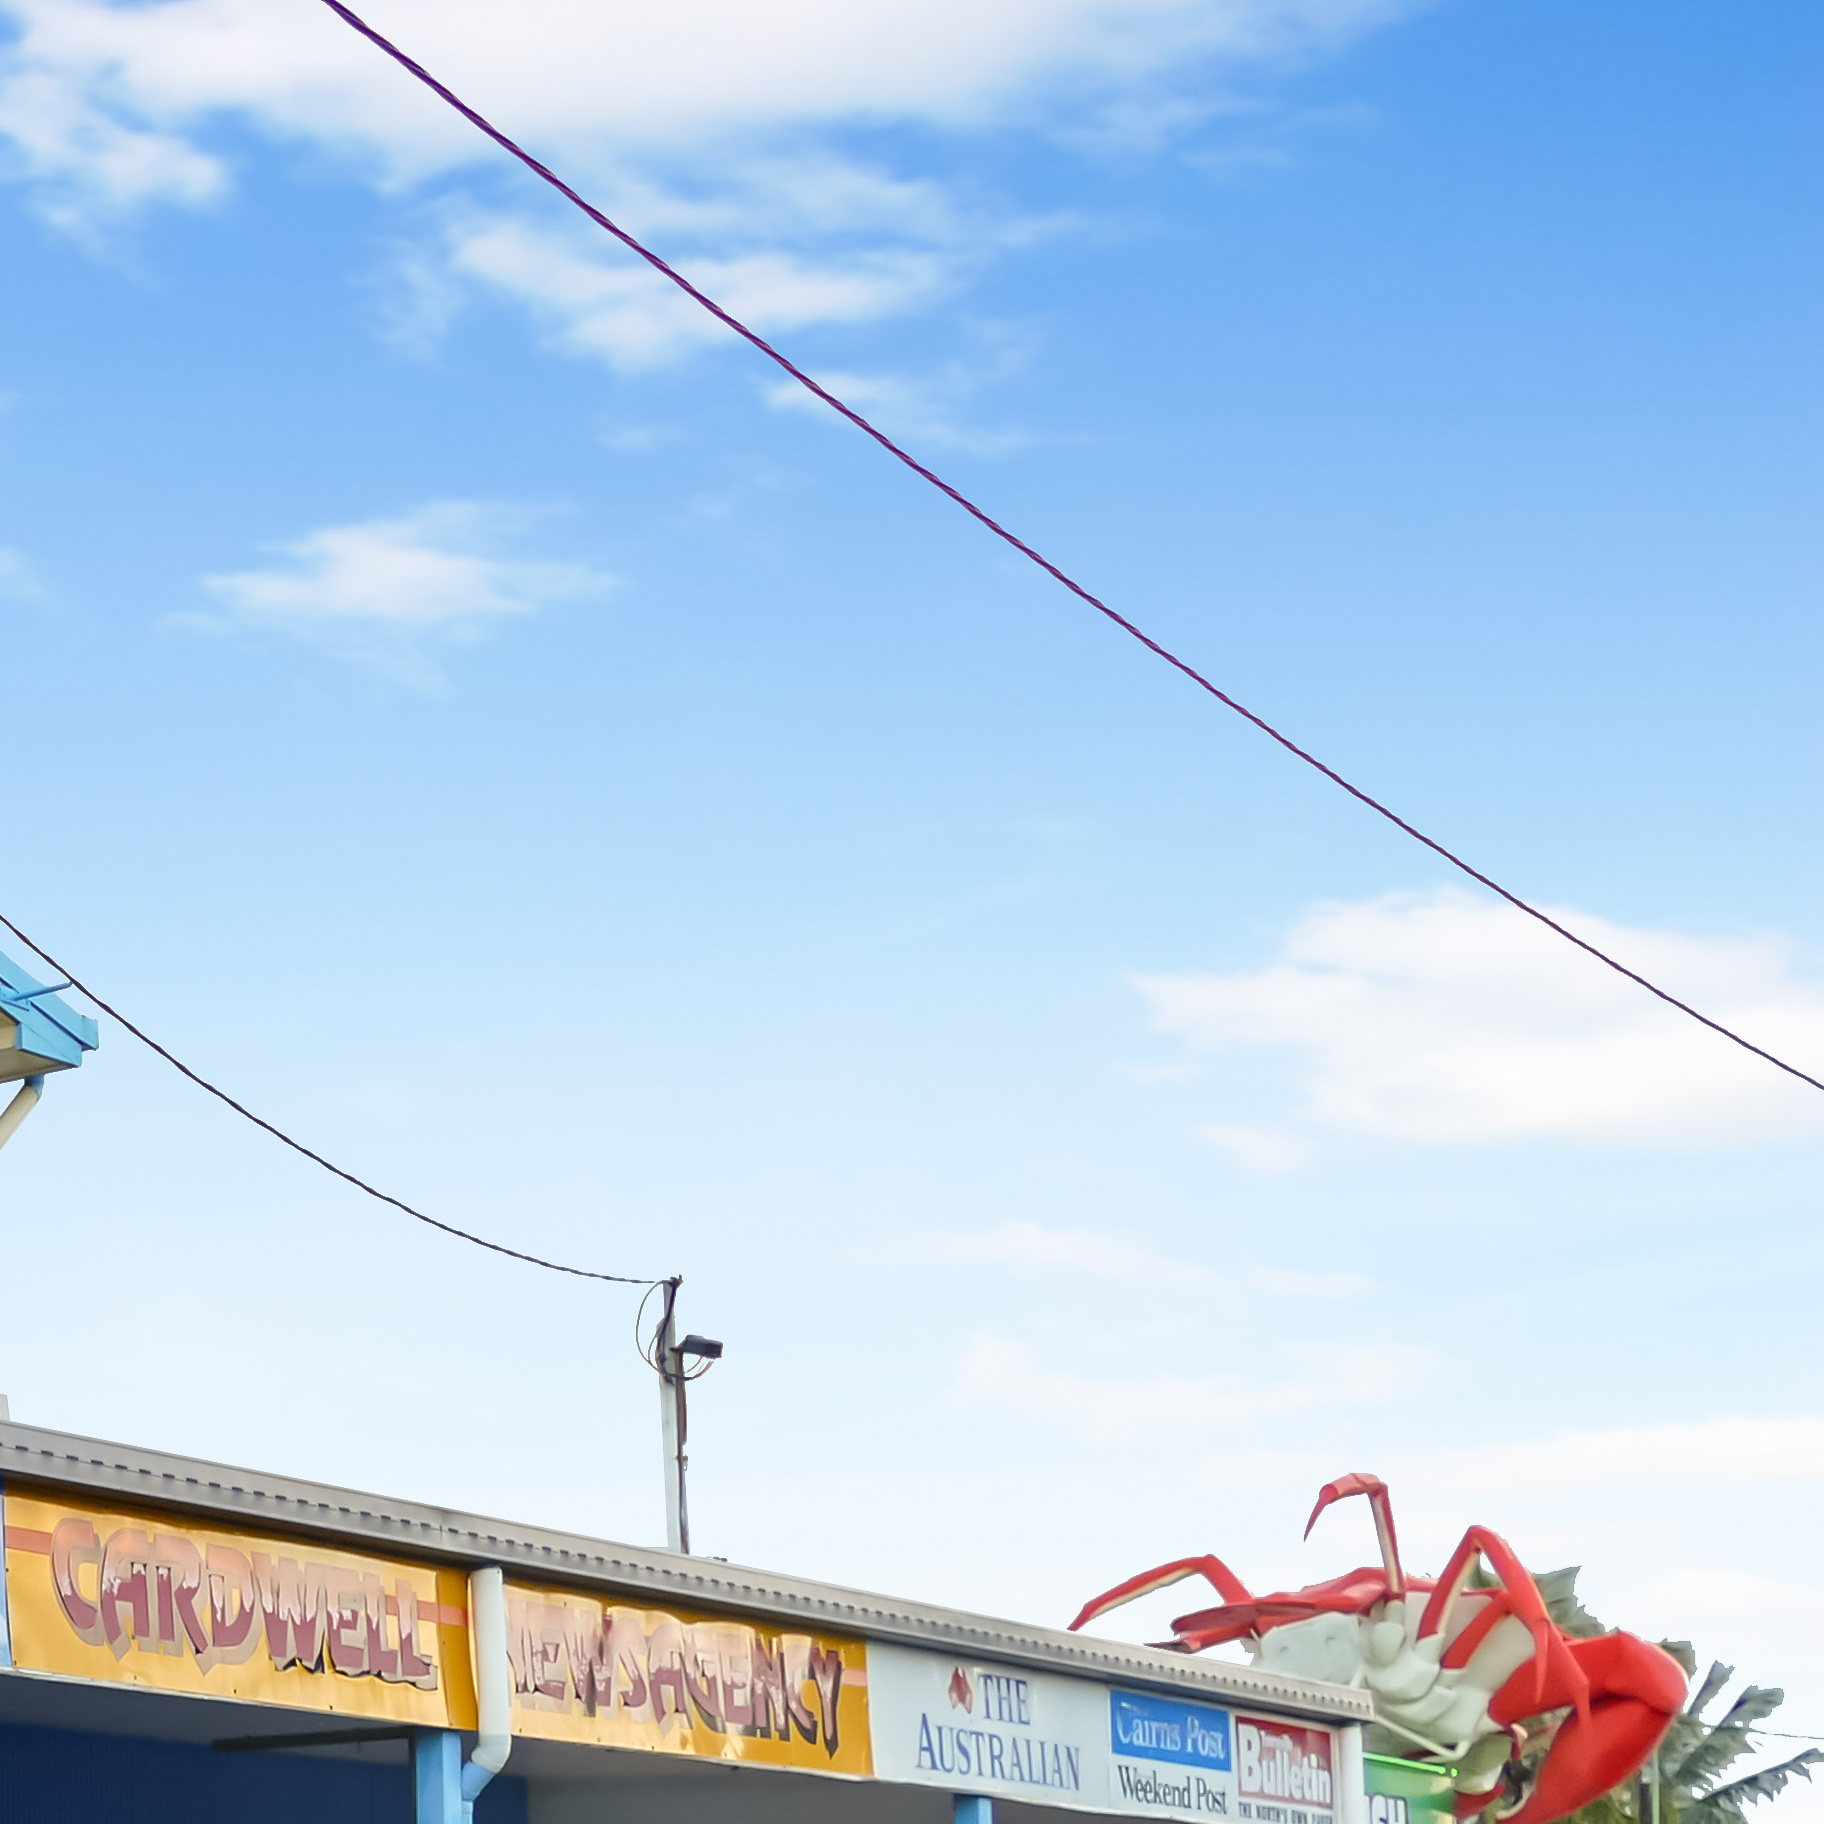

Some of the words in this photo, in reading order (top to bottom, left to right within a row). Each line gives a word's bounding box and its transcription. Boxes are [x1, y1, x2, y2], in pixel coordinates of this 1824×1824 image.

[52, 1517, 438, 1691] CARDWELL
[978, 1673, 1031, 1726] THE
[1115, 1704, 1182, 1752] Cairns
[1187, 1715, 1225, 1761] Post
[916, 1712, 1081, 1792] AUSTRALIAN
[1238, 1723, 1332, 1804] Bulletin
[1118, 1764, 1192, 1810] Weekend
[1196, 1776, 1228, 1815] Post
